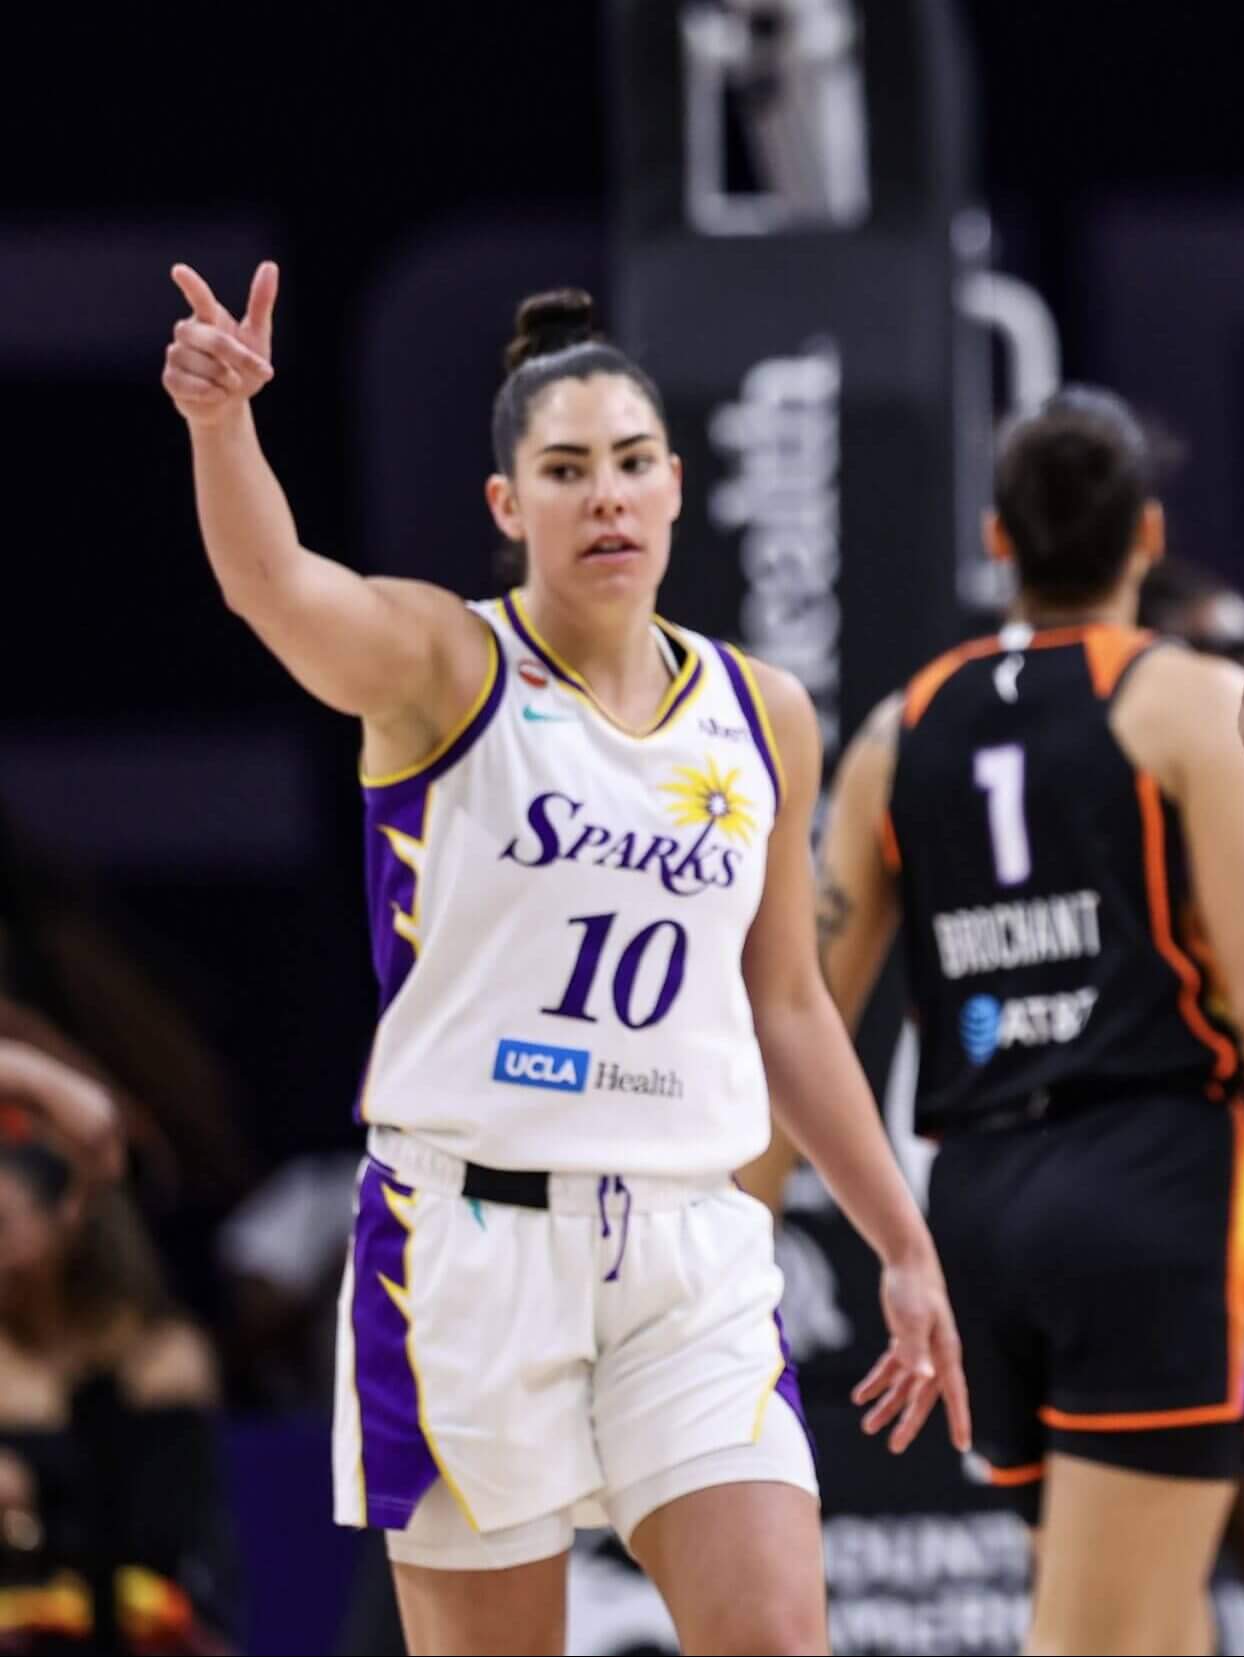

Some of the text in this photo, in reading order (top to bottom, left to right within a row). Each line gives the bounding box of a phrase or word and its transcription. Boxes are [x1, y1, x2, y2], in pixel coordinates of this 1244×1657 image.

[499, 791, 742, 896] SPARKS
[973, 744, 1031, 885] 1
[540, 911, 689, 1030] 10
[505, 1051, 684, 1099] UCLA Health
